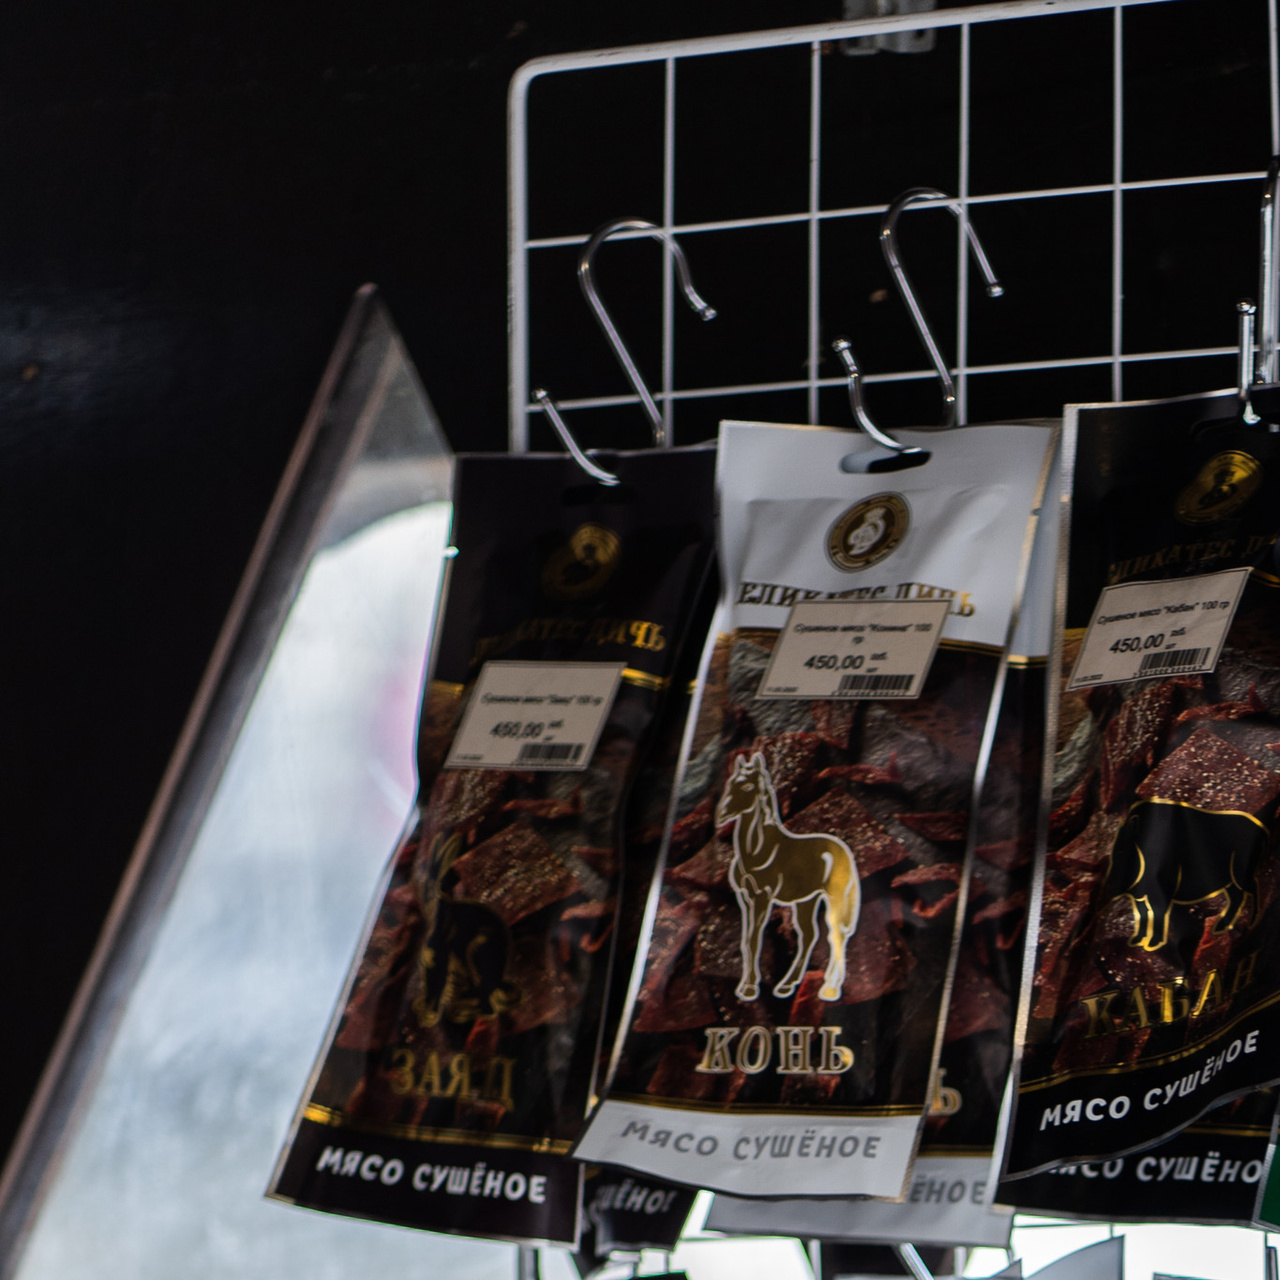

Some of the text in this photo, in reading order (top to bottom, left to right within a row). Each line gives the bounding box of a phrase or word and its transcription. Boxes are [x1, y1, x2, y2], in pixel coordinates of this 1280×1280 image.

[804, 654, 865, 672] 450,00
[1110, 633, 1165, 655] 450,00
[1081, 950, 1260, 1040] КАБАН
[695, 1025, 855, 1075] КОНЬ
[1039, 1030, 1260, 1131] МЯСО СУШЁНОЕ
[621, 1120, 882, 1160] МЯСО СУШЁНОЕ
[315, 1146, 548, 1204] МЯСО СУШЁНОЕ
[1136, 1152, 1264, 1184] СУШЁНО
[911, 1174, 988, 1206] ЁНОЕ
